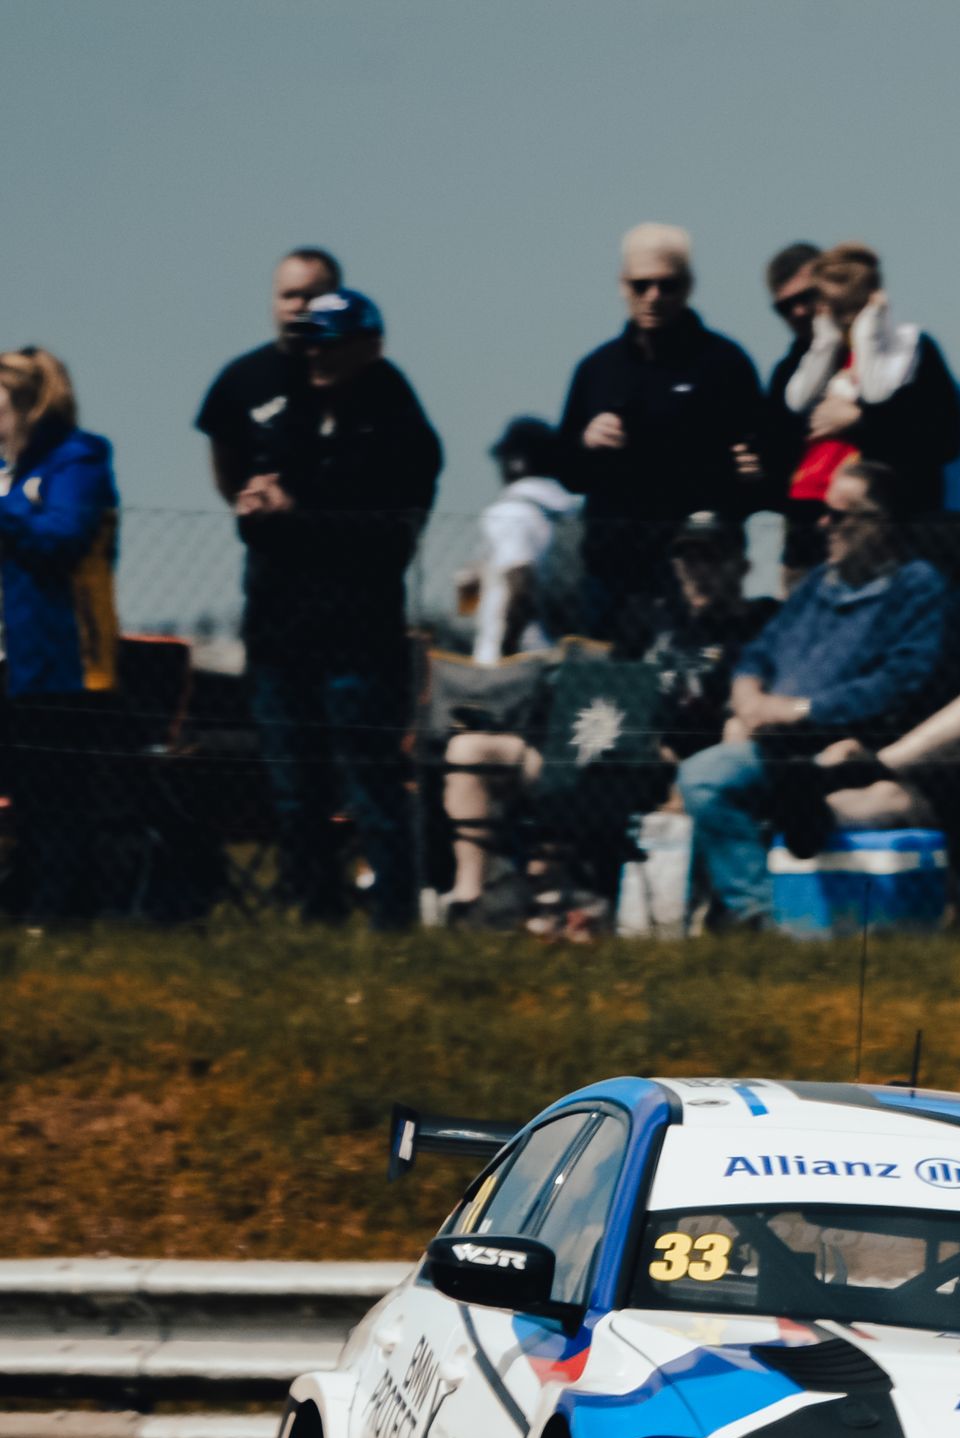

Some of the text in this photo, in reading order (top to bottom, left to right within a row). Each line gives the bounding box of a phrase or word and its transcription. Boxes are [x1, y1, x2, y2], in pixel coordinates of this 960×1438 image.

[723, 1154, 901, 1179] Allianz
[451, 1242, 528, 1270] WSR
[648, 1231, 733, 1282] 33
[403, 1334, 440, 1414] BMW
